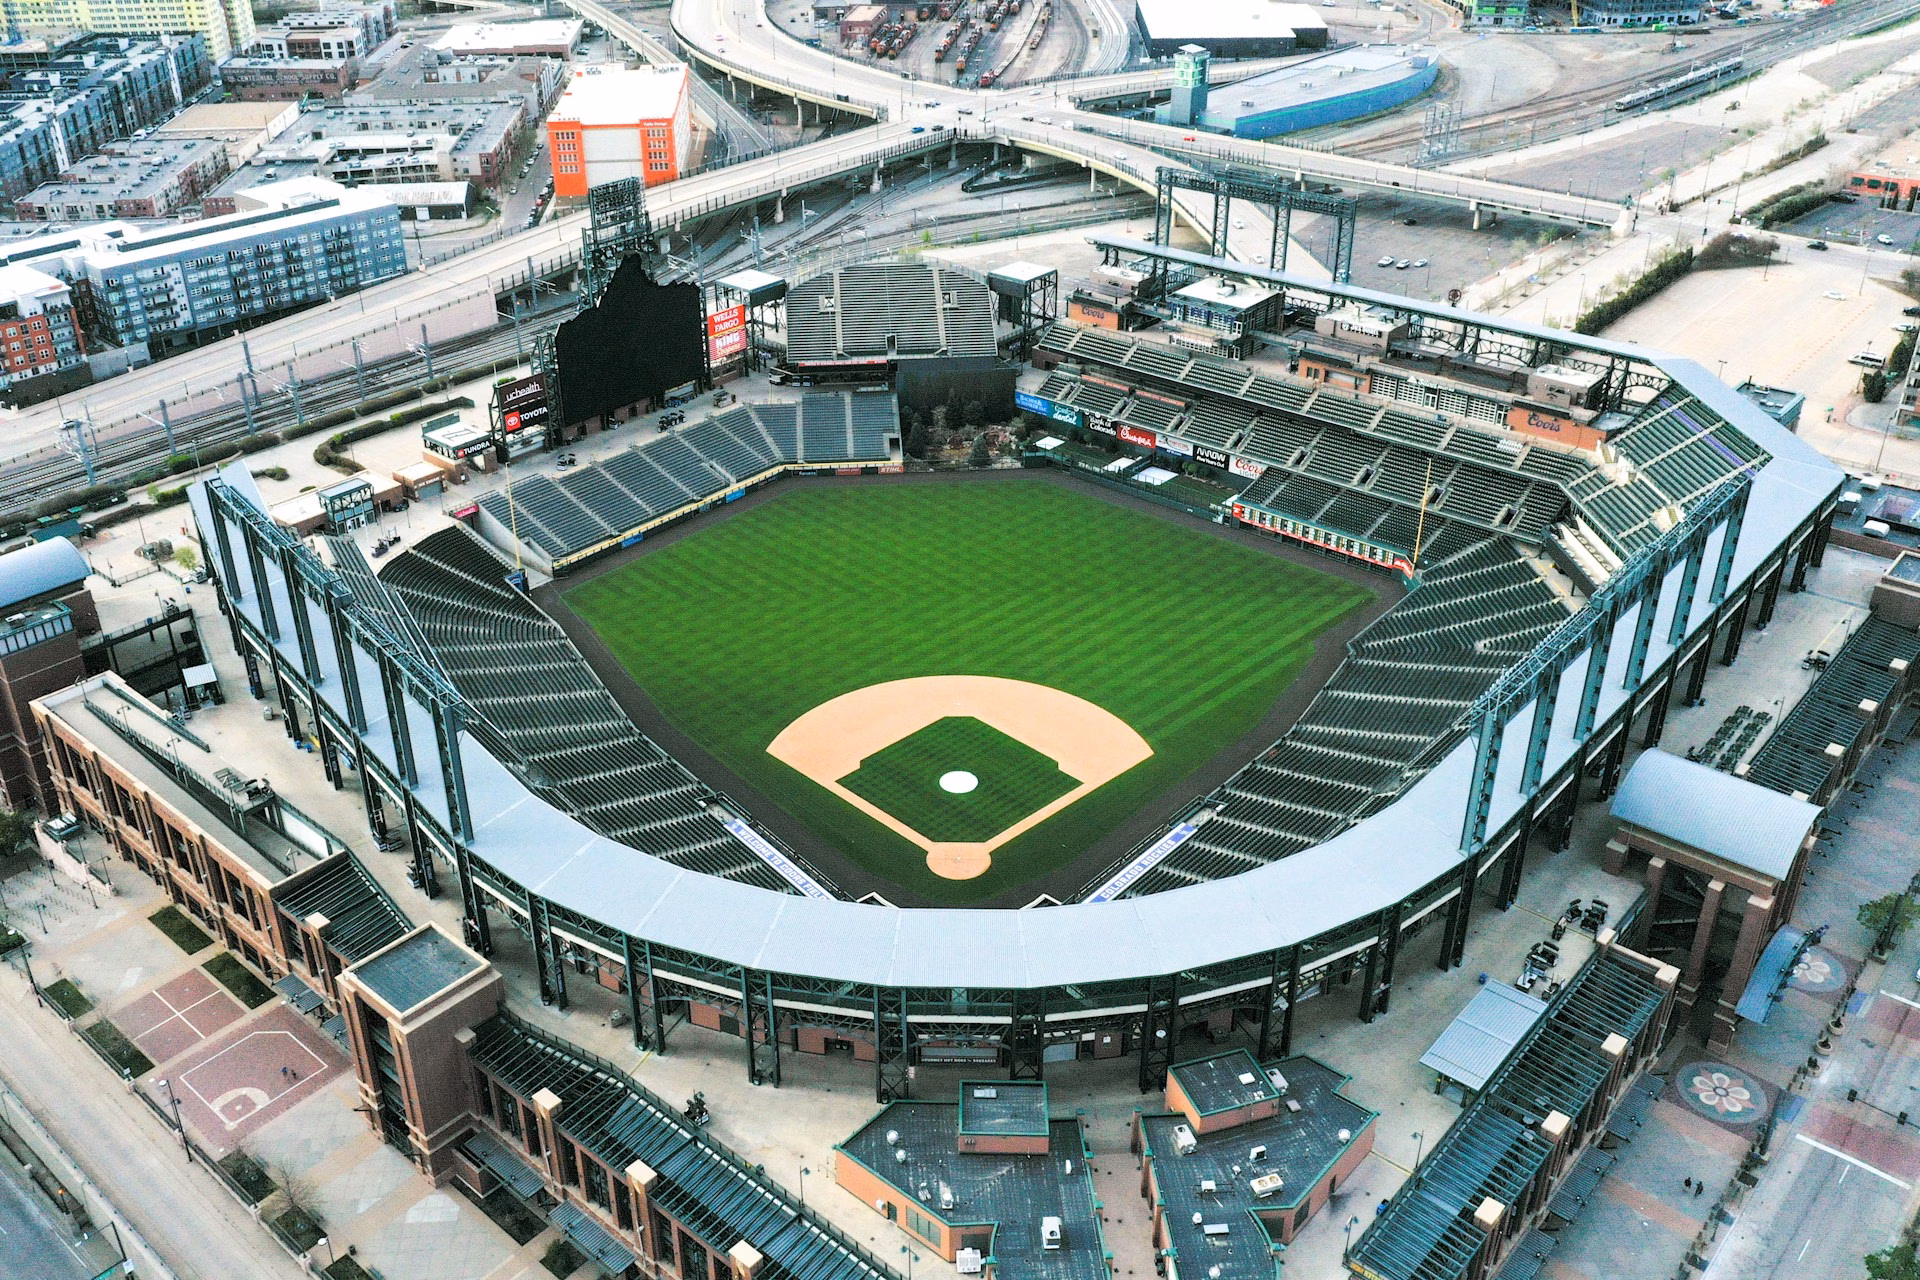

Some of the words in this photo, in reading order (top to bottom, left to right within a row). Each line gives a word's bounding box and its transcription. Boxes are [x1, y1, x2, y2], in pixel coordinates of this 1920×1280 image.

[713, 308, 739, 323] WELLS
[1082, 305, 1105, 320] Coors
[714, 318, 739, 333] FARGO
[715, 331, 741, 349] KING
[505, 382, 542, 402] uchealth
[519, 406, 548, 422] TOYOTA
[1052, 411, 1078, 426] dental
[1089, 415, 1105, 426] Bank
[1089, 422, 1117, 436] Colorado
[1527, 412, 1561, 432] Coors
[463, 440, 491, 455] TUNDRA
[1196, 447, 1226, 462] ARROW
[1196, 455, 1205, 463] Five
[1205, 458, 1217, 466] Years
[1217, 461, 1225, 469] Out
[1235, 457, 1264, 475] Coors
[739, 828, 772, 859] WELCOME
[770, 854, 782, 866] TO
[781, 862, 804, 884] COORS
[1101, 864, 1143, 898] COLORADO
[1143, 839, 1175, 867] ROCKIES
